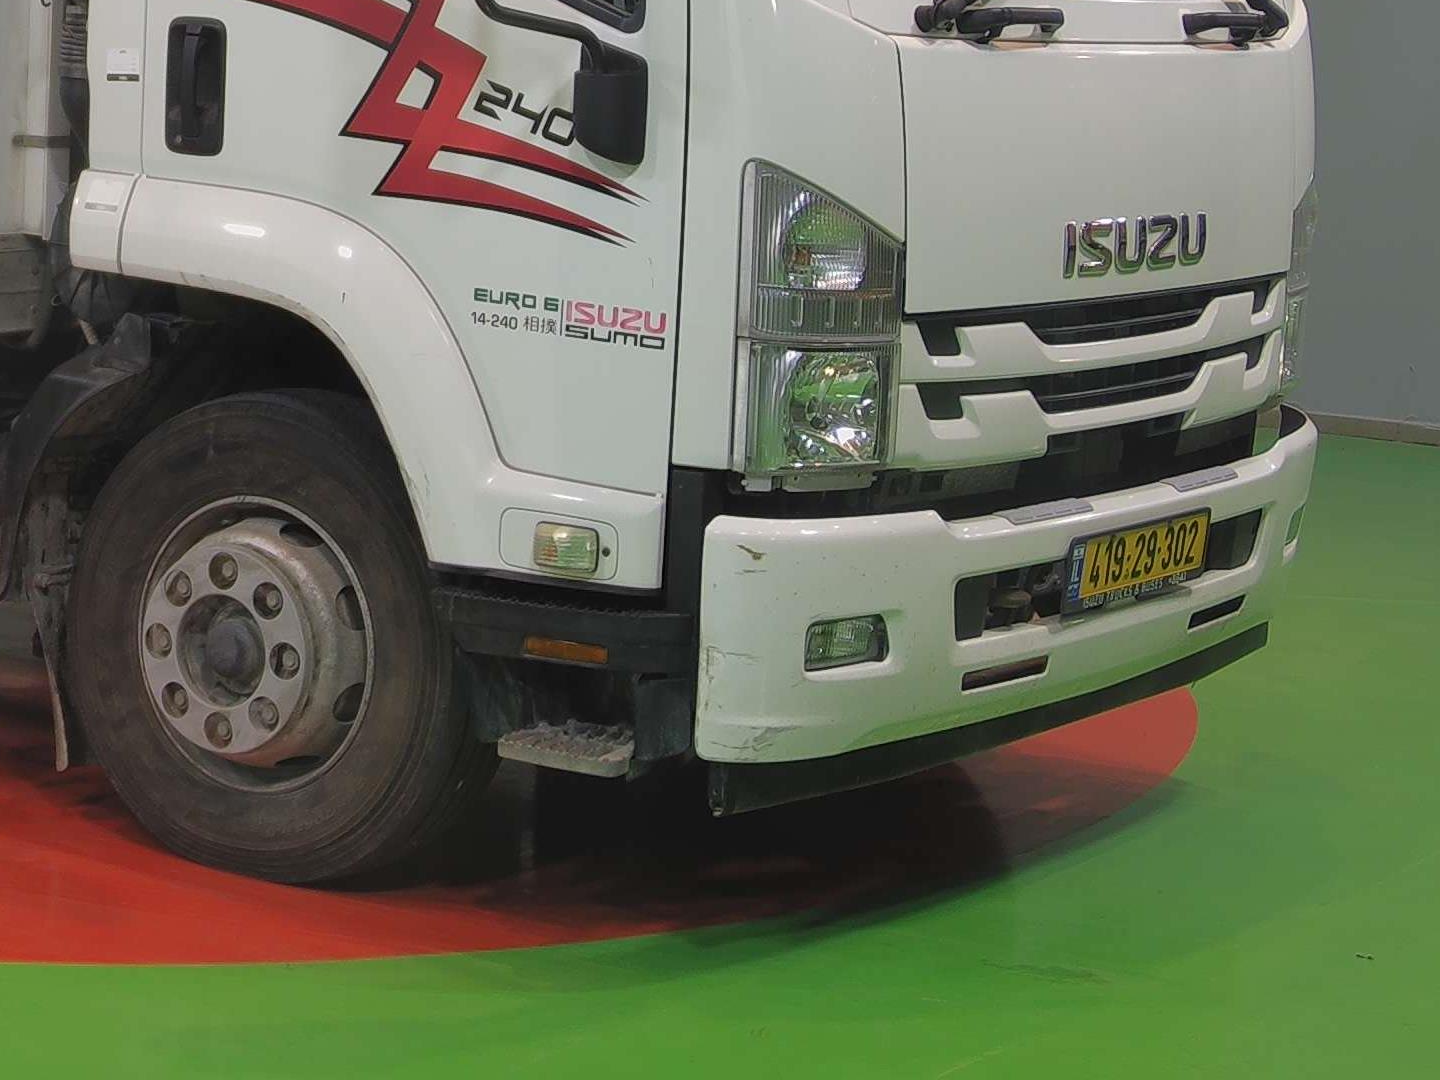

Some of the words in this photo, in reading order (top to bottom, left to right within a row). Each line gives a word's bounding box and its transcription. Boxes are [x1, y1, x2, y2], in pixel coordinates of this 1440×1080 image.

[473, 79, 576, 147] 240
[1063, 211, 1207, 279] ISUZU
[474, 287, 536, 310] EURO
[544, 297, 559, 312] 6
[471, 311, 518, 331] 14-240
[565, 300, 667, 334] ISUZU
[565, 324, 666, 350] SUMO
